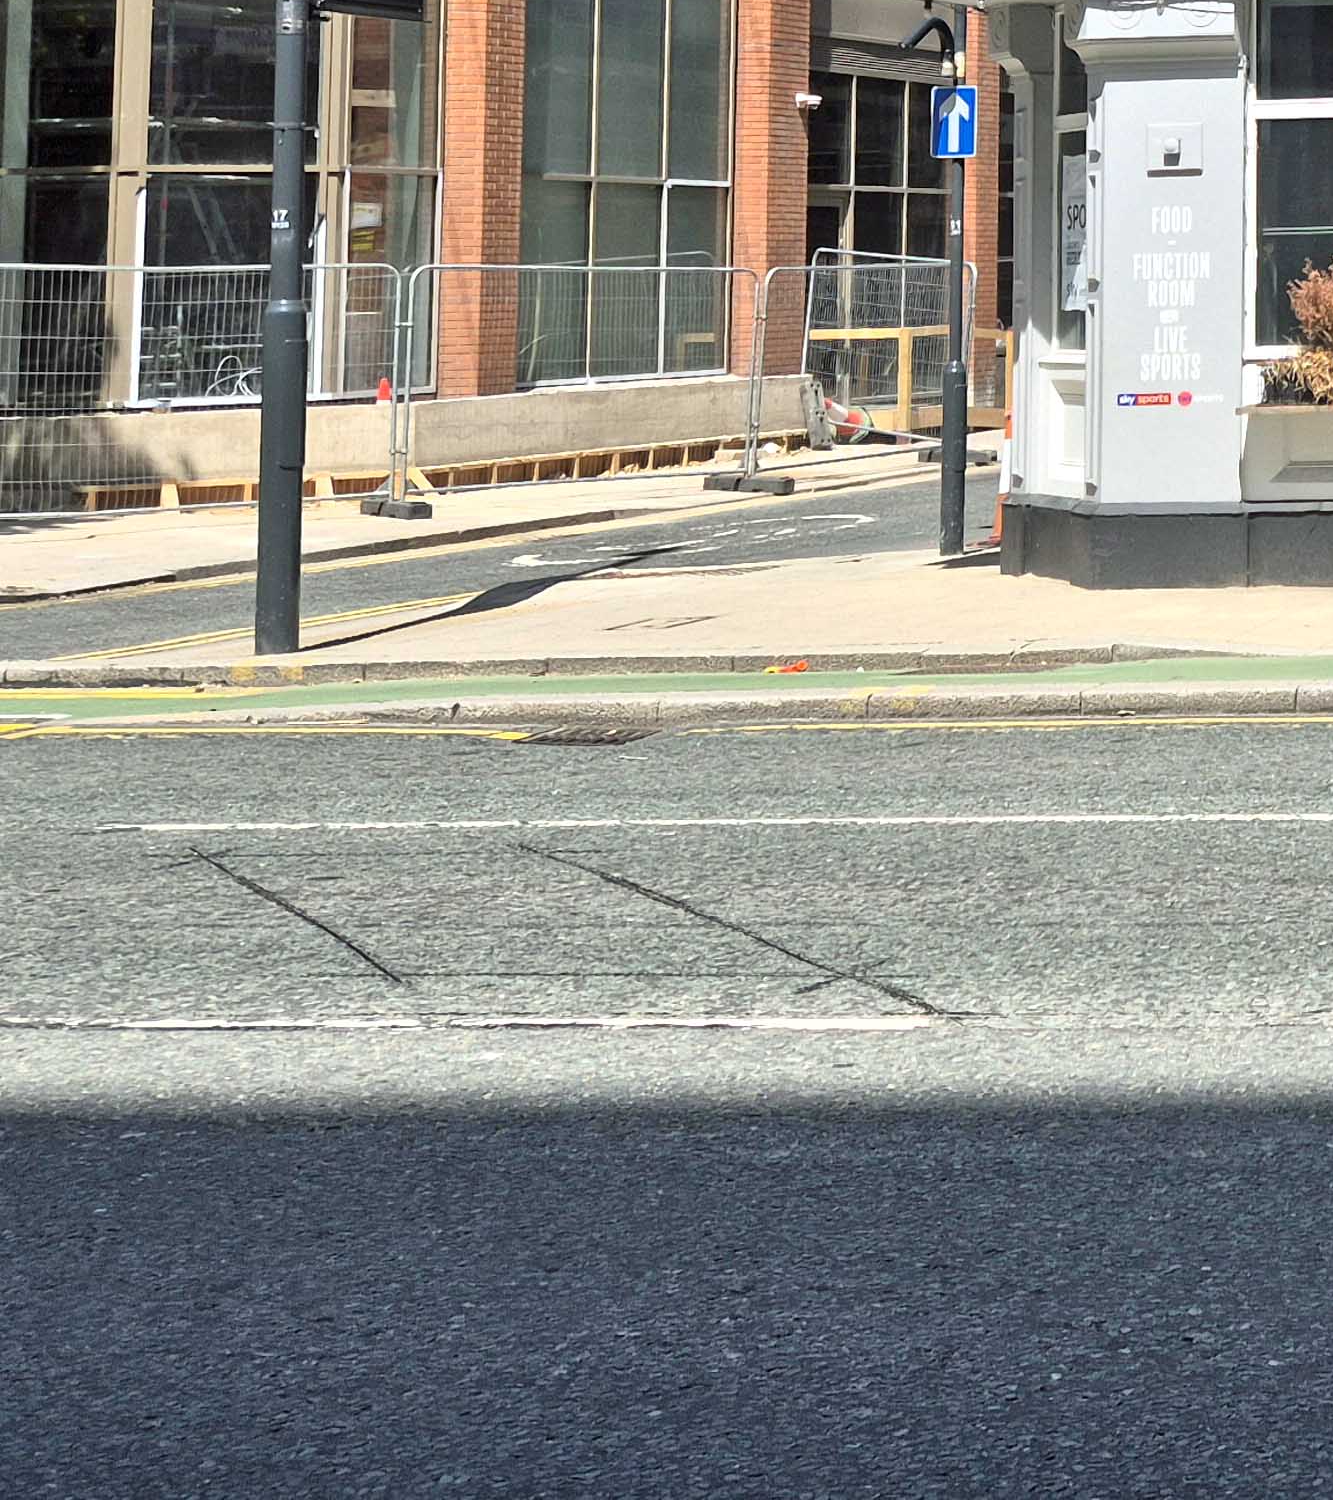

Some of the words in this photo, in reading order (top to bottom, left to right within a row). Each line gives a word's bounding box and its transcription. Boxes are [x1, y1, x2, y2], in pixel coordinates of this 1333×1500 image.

[272, 209, 289, 221] 17
[1151, 205, 1193, 234] FOOD
[1132, 251, 1211, 281] FUNCTION
[1147, 280, 1195, 308] ROOM
[1153, 325, 1188, 353] LIVE
[1140, 352, 1201, 382] SPORTS
[1119, 395, 1136, 406] sky
